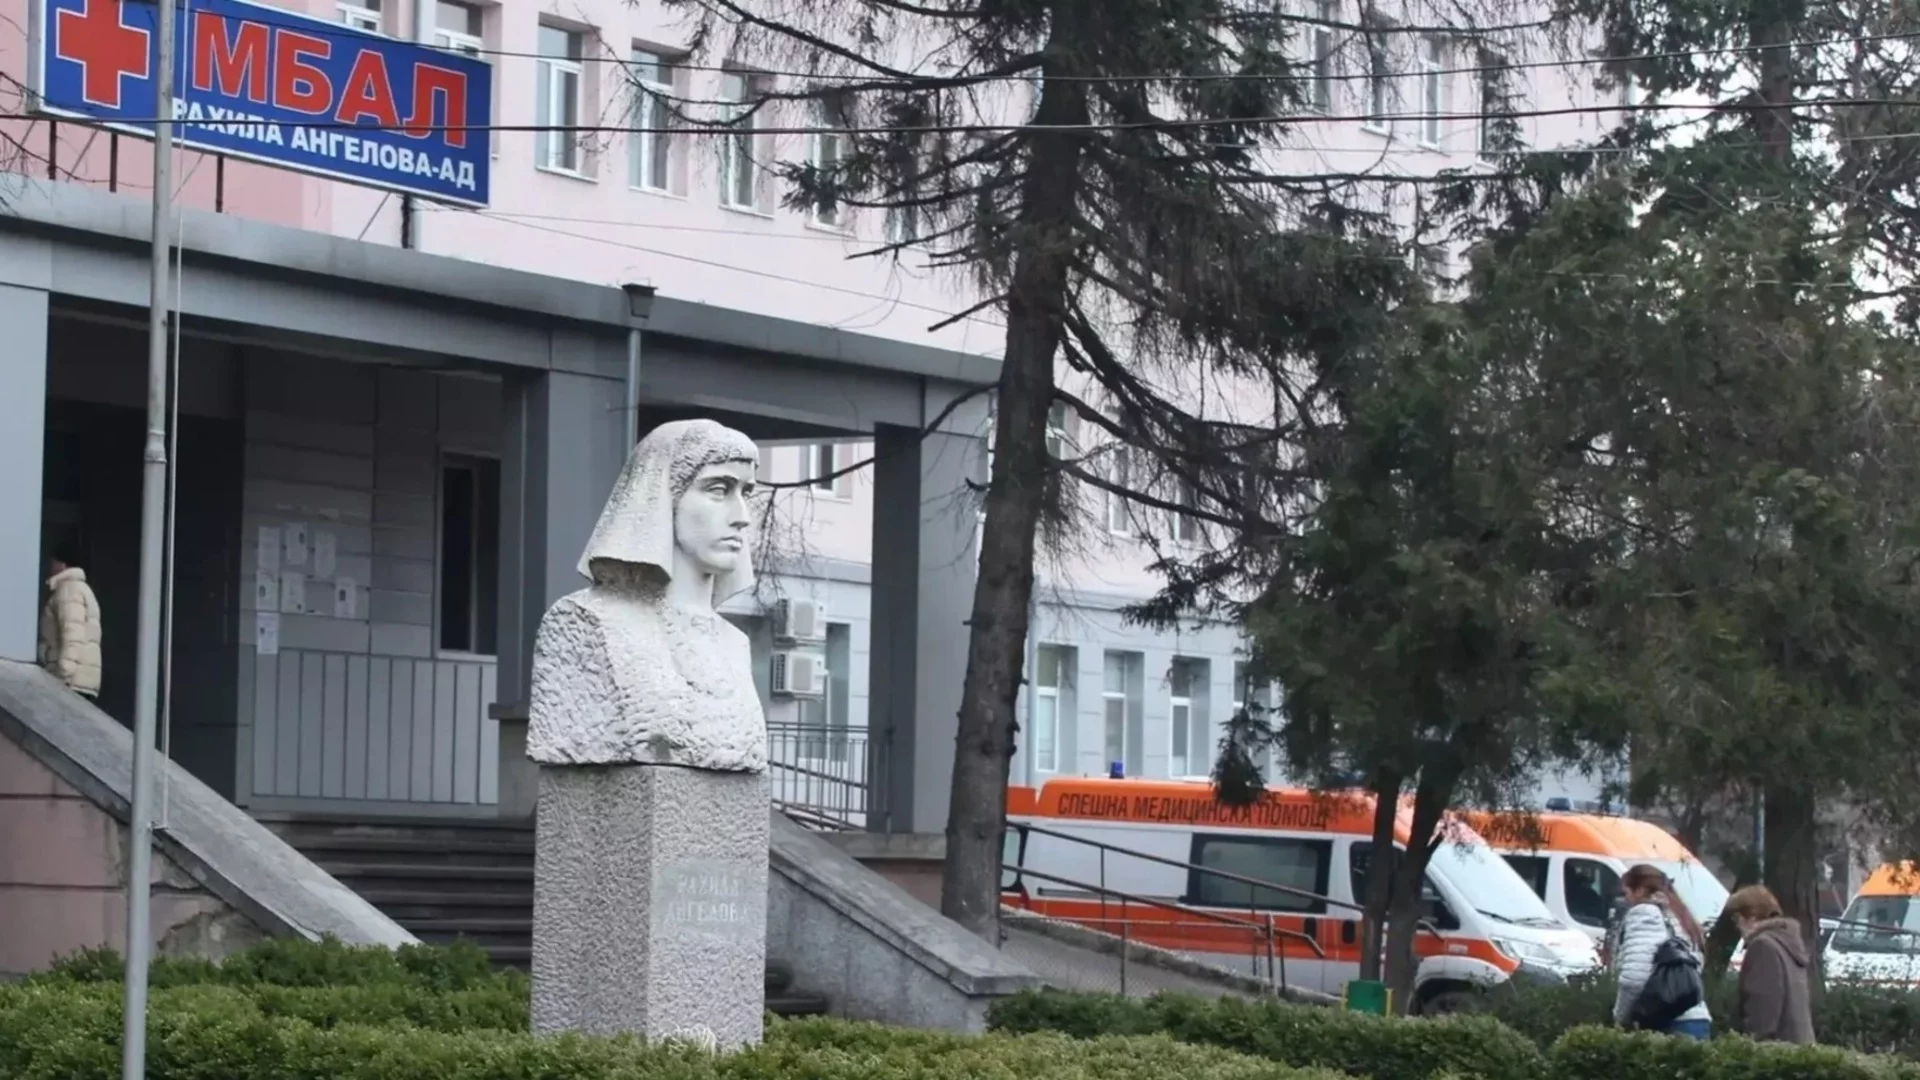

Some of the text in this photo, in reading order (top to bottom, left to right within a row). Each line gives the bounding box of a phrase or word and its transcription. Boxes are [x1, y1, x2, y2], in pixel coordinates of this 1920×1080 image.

[192, 9, 467, 148] МБАЛ
[172, 97, 476, 192] РАХИЛА АНГЕЛОВА-АД
[1058, 793, 1327, 830] СПЕШНА МЕДИЦИНСКА ПОМОЩ
